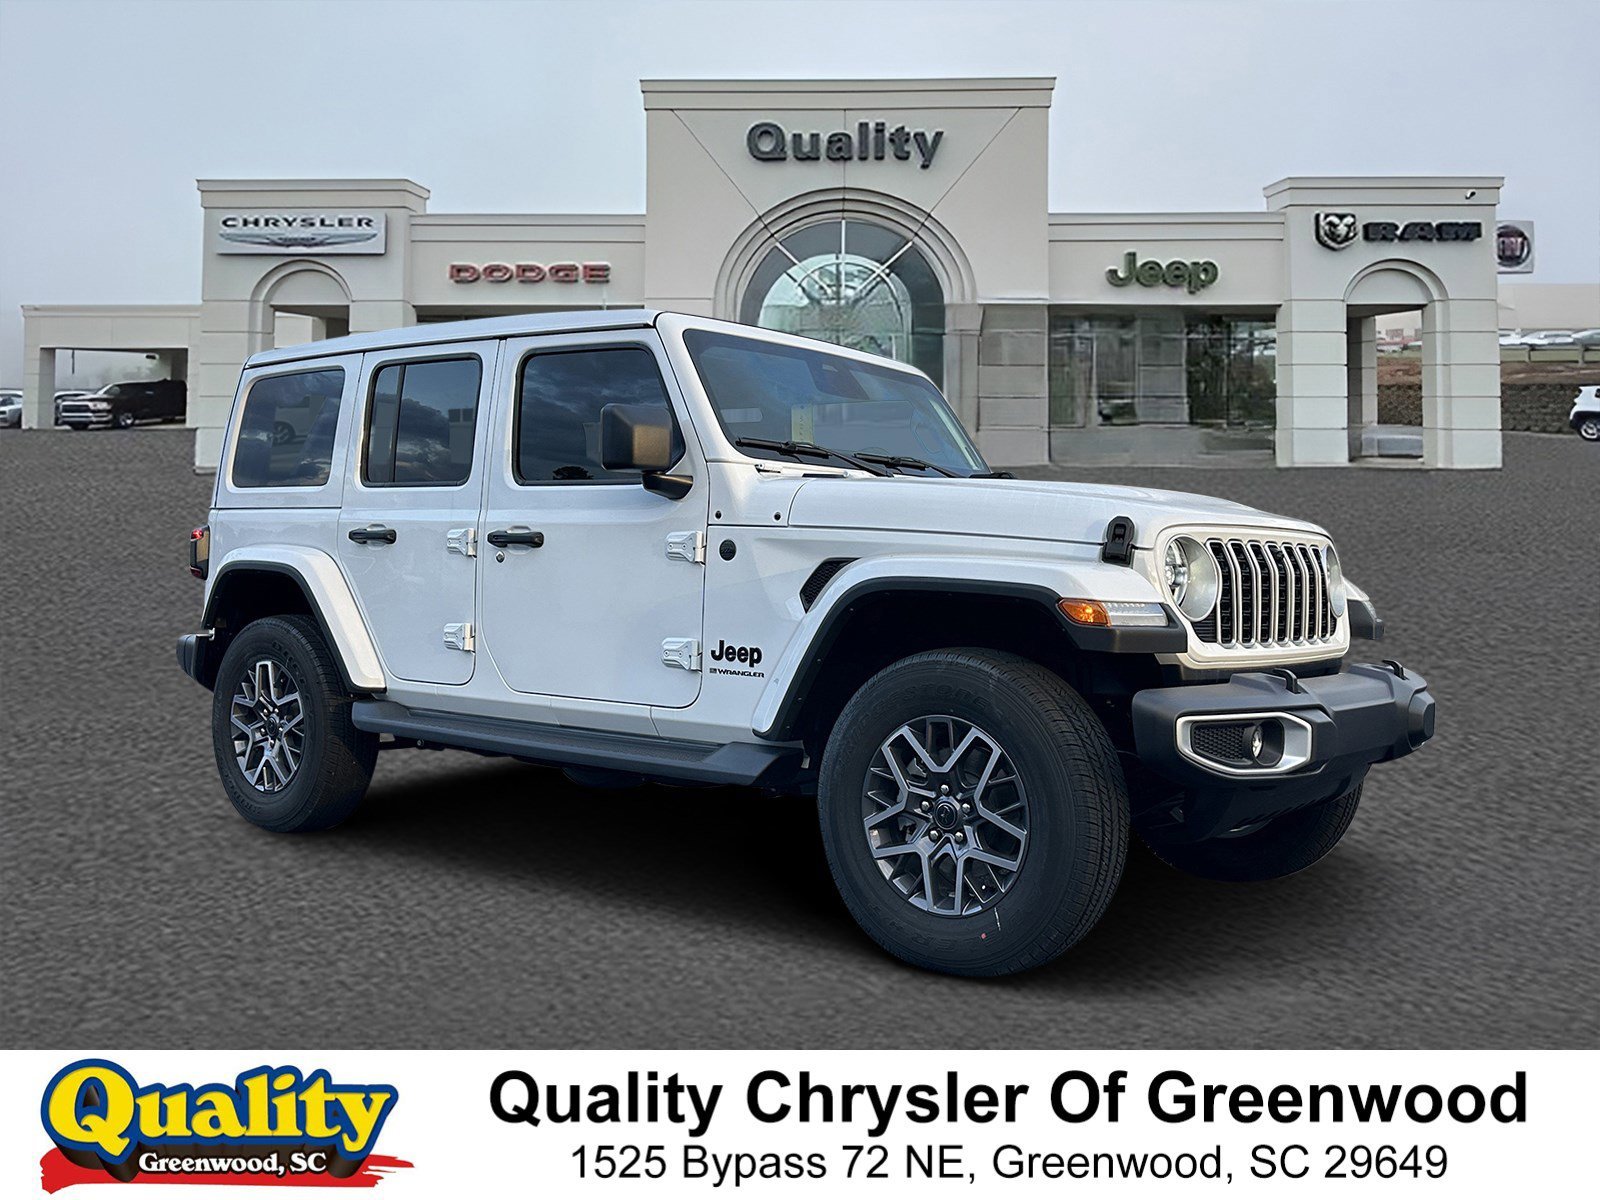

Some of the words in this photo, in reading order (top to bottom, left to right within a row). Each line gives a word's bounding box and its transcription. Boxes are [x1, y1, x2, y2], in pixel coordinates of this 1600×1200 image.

[746, 120, 944, 170] Quality
[221, 216, 374, 228] CHRYSLER
[1362, 220, 1482, 242] RAM
[448, 262, 611, 284] DODGE
[1105, 251, 1219, 294] Jeep
[710, 639, 763, 668] Jeep
[717, 668, 765, 678] WRANGLER
